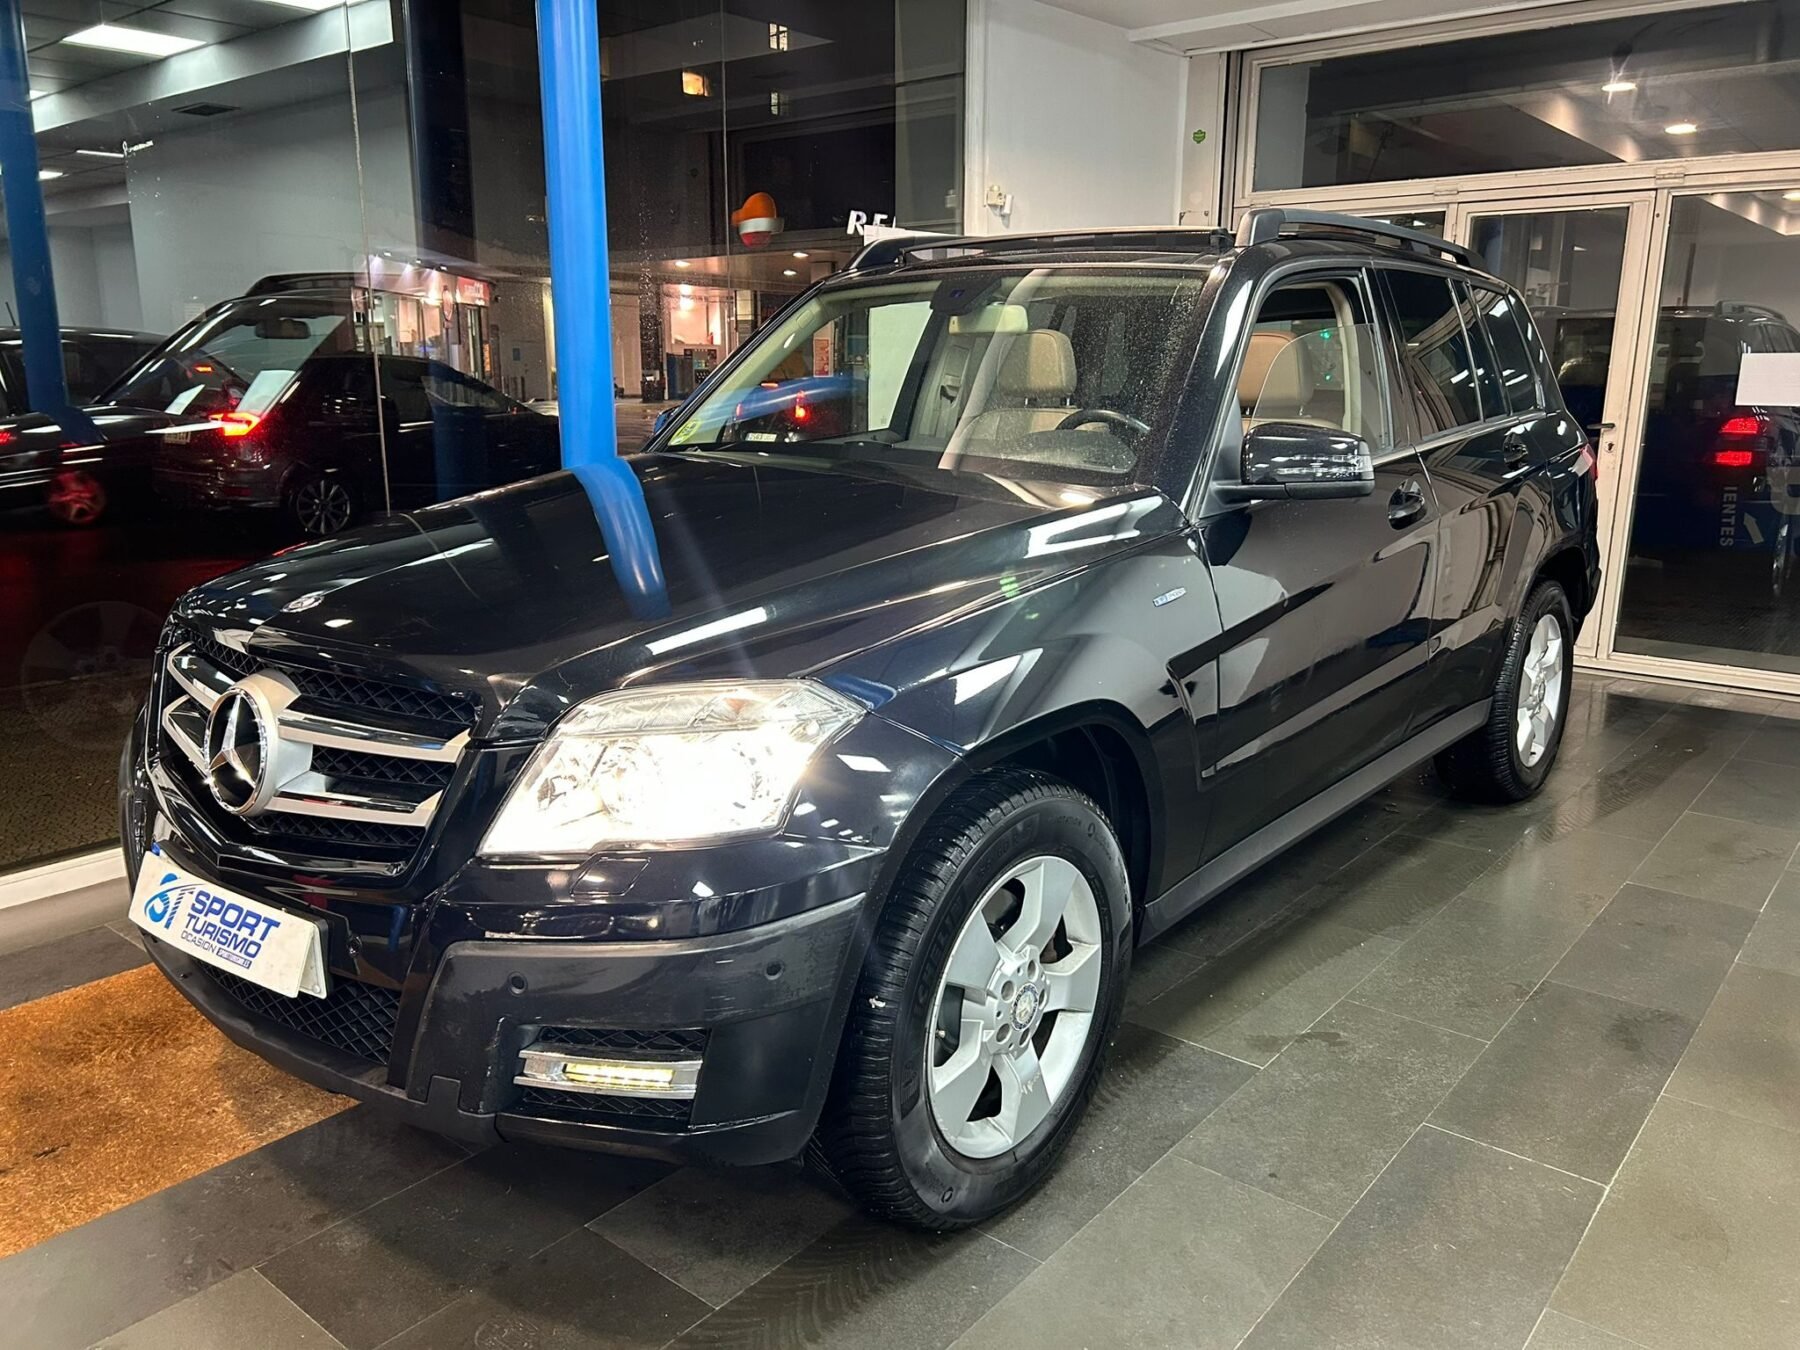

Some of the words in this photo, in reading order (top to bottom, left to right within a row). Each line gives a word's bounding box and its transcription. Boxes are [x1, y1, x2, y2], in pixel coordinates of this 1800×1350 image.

[185, 913, 262, 959] TURISMO
[190, 891, 280, 942] SPORT
[181, 930, 216, 954] OCASION
